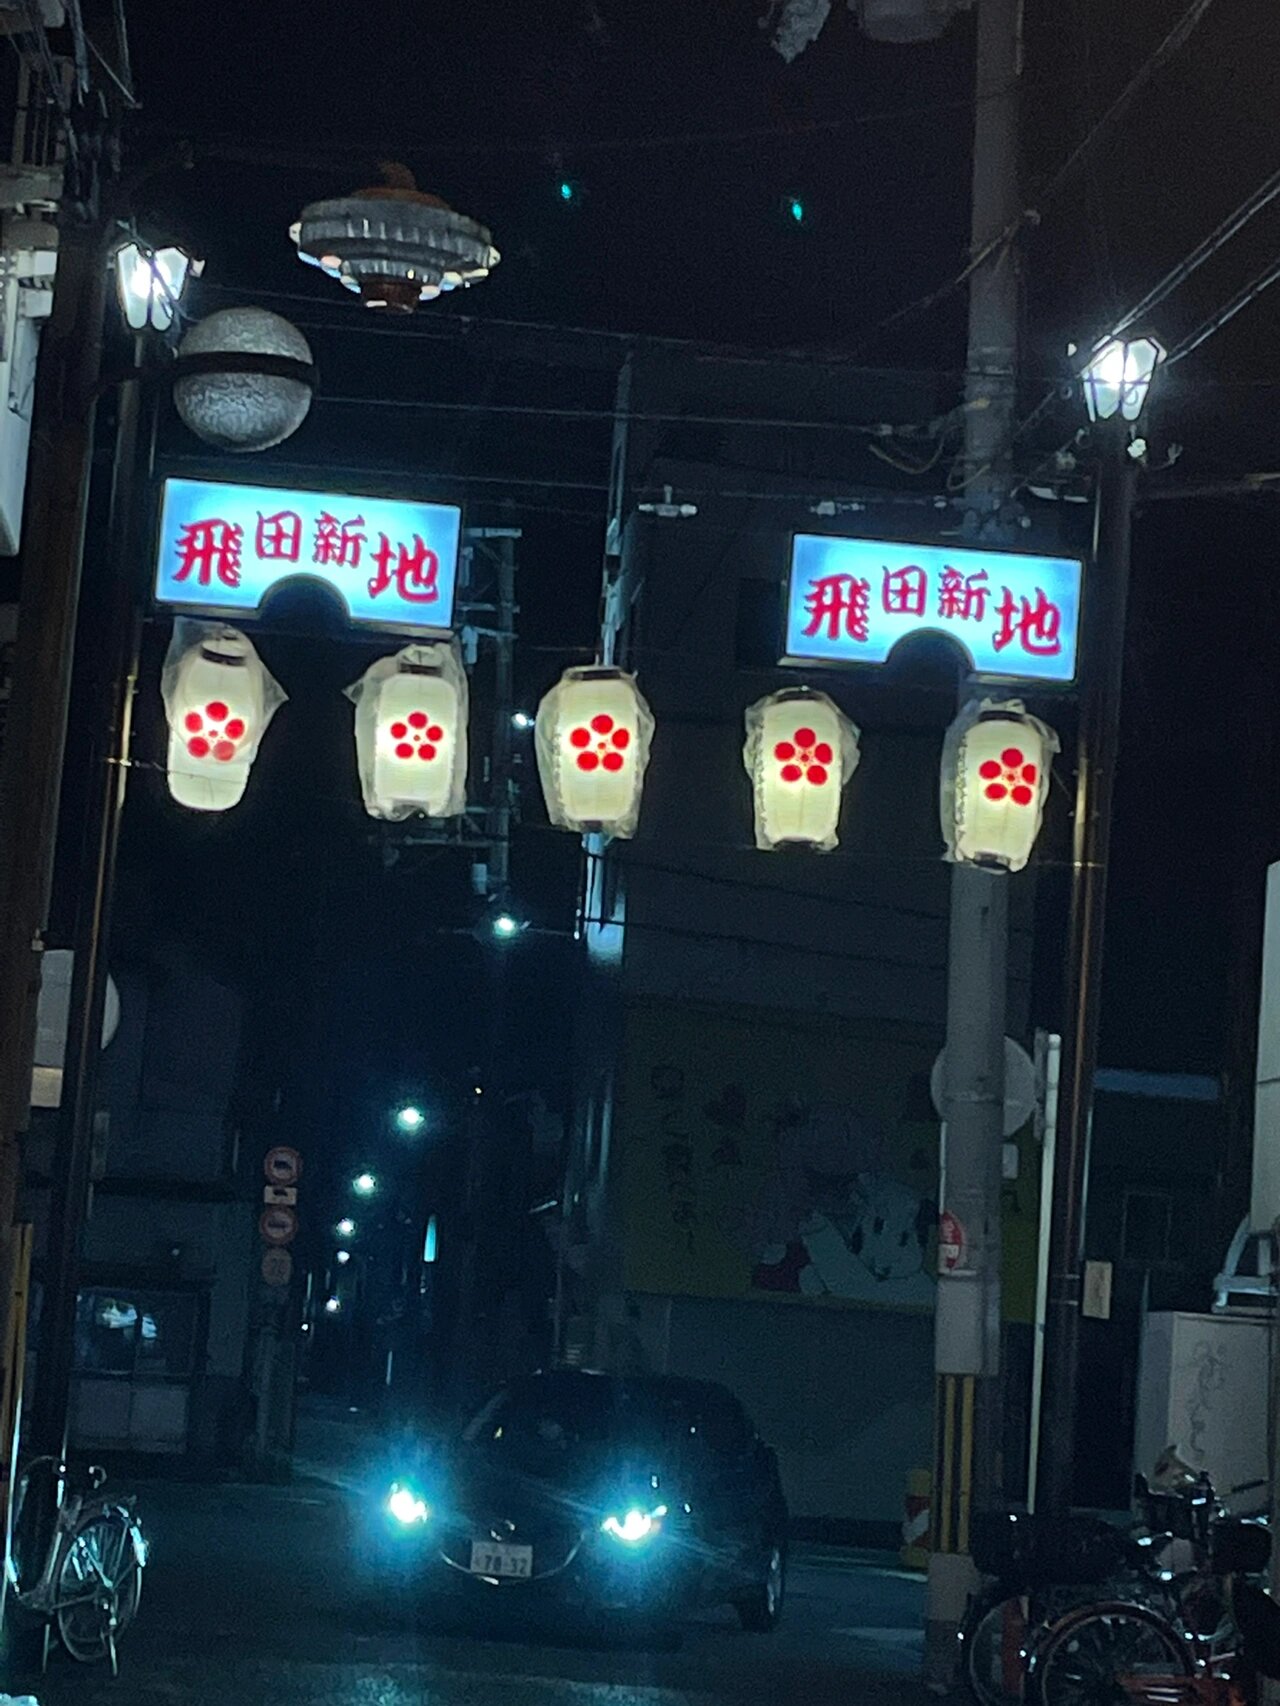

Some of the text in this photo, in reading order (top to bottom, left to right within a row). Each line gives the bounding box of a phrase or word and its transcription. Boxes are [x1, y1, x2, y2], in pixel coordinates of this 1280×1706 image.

[172, 510, 440, 604] 飛田新地
[801, 565, 1062, 656] 飛田新地
